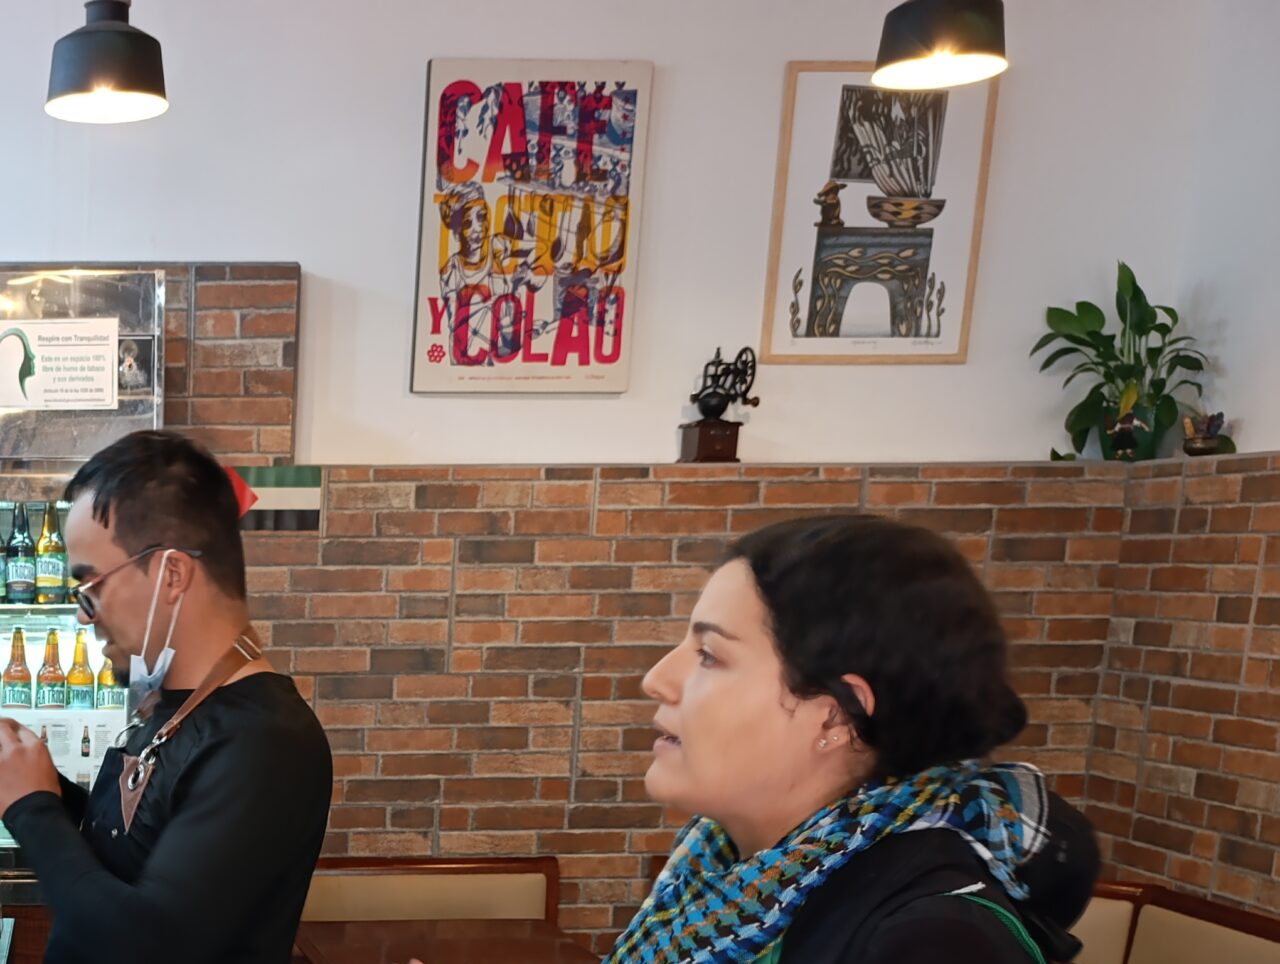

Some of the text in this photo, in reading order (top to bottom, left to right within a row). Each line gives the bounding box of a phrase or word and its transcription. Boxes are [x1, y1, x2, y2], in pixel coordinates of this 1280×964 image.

[433, 193, 631, 276] TOSTAO
[37, 334, 60, 343] Respire
[74, 333, 110, 343] Tranquilidad
[428, 284, 626, 367] Y COLAO
